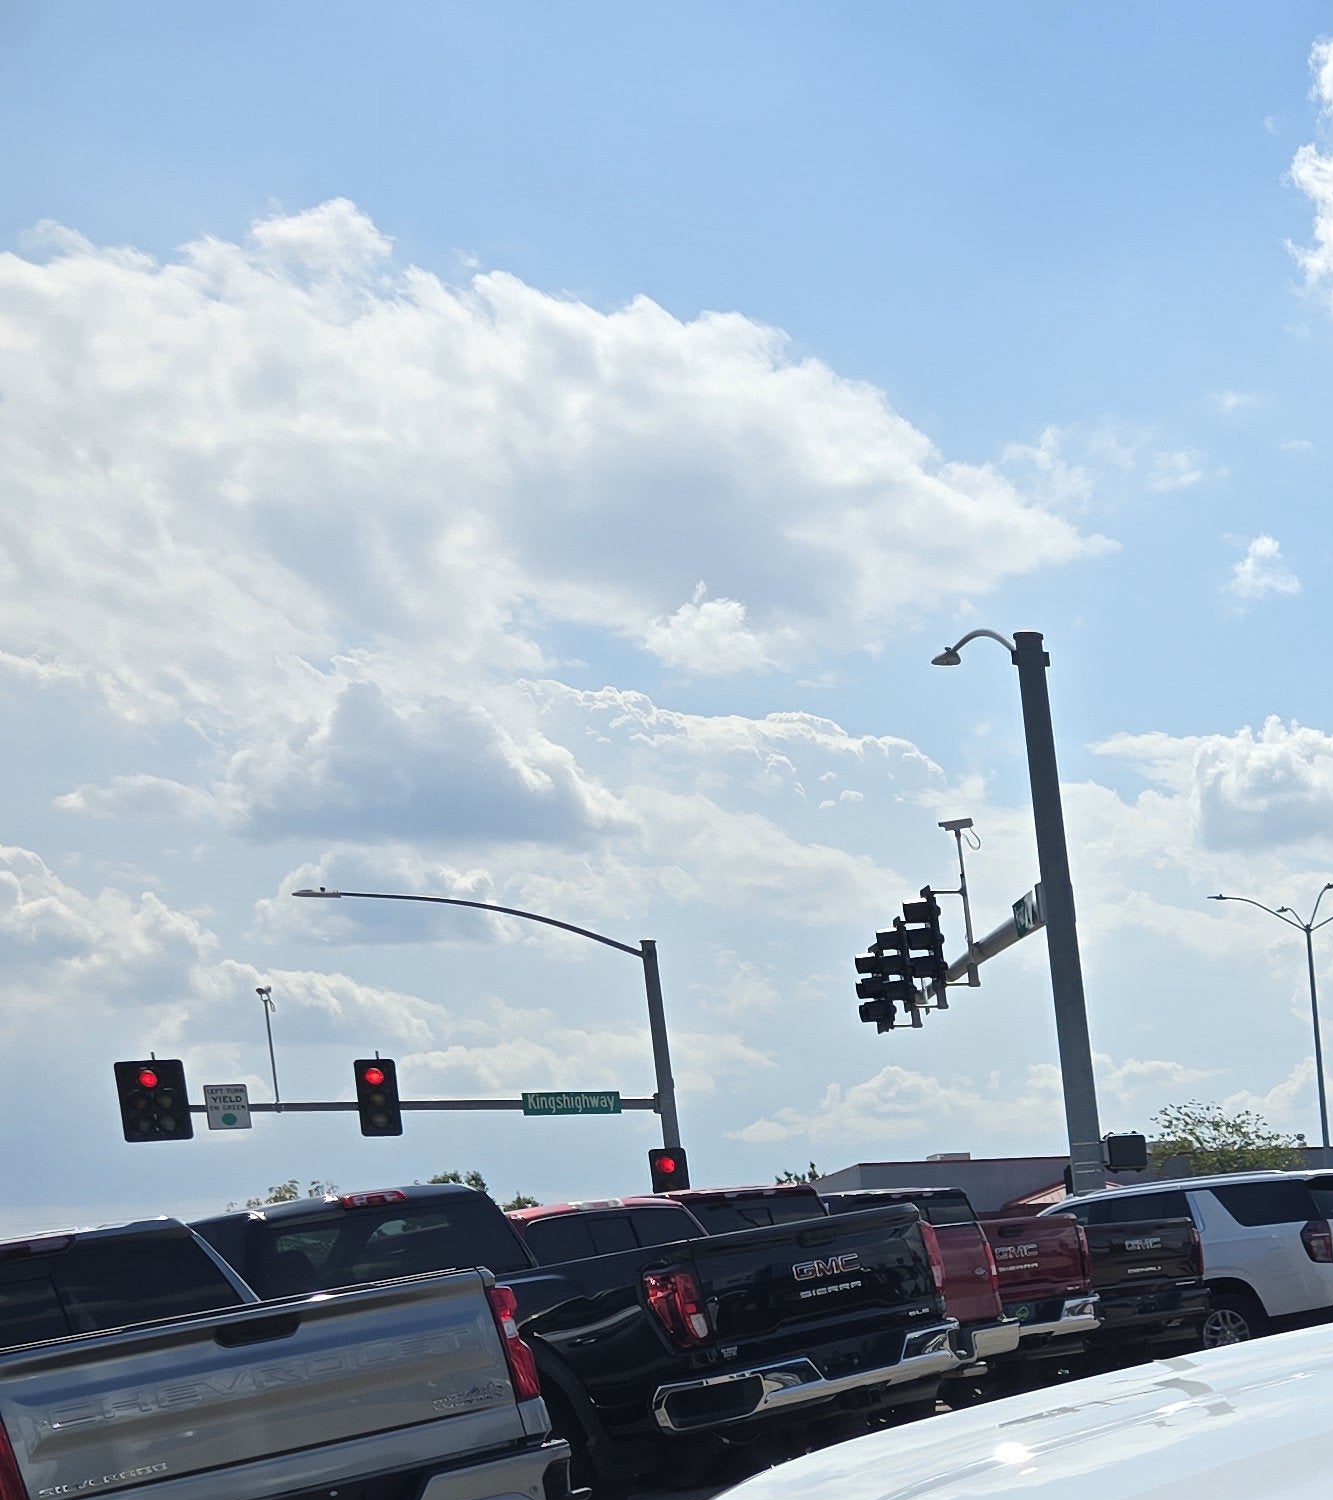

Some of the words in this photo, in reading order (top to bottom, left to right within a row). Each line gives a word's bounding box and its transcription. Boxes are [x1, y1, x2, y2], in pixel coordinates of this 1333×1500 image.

[211, 1095, 243, 1104] YIELD
[527, 1093, 615, 1114] Kingshighway
[995, 1243, 1039, 1260] GMC
[1124, 1237, 1162, 1251] GMC
[791, 1253, 861, 1282] GMC
[800, 1280, 862, 1299] SIERRA
[46, 1327, 483, 1430] CHEVROLET
[38, 1462, 169, 1499] SILVERADO
